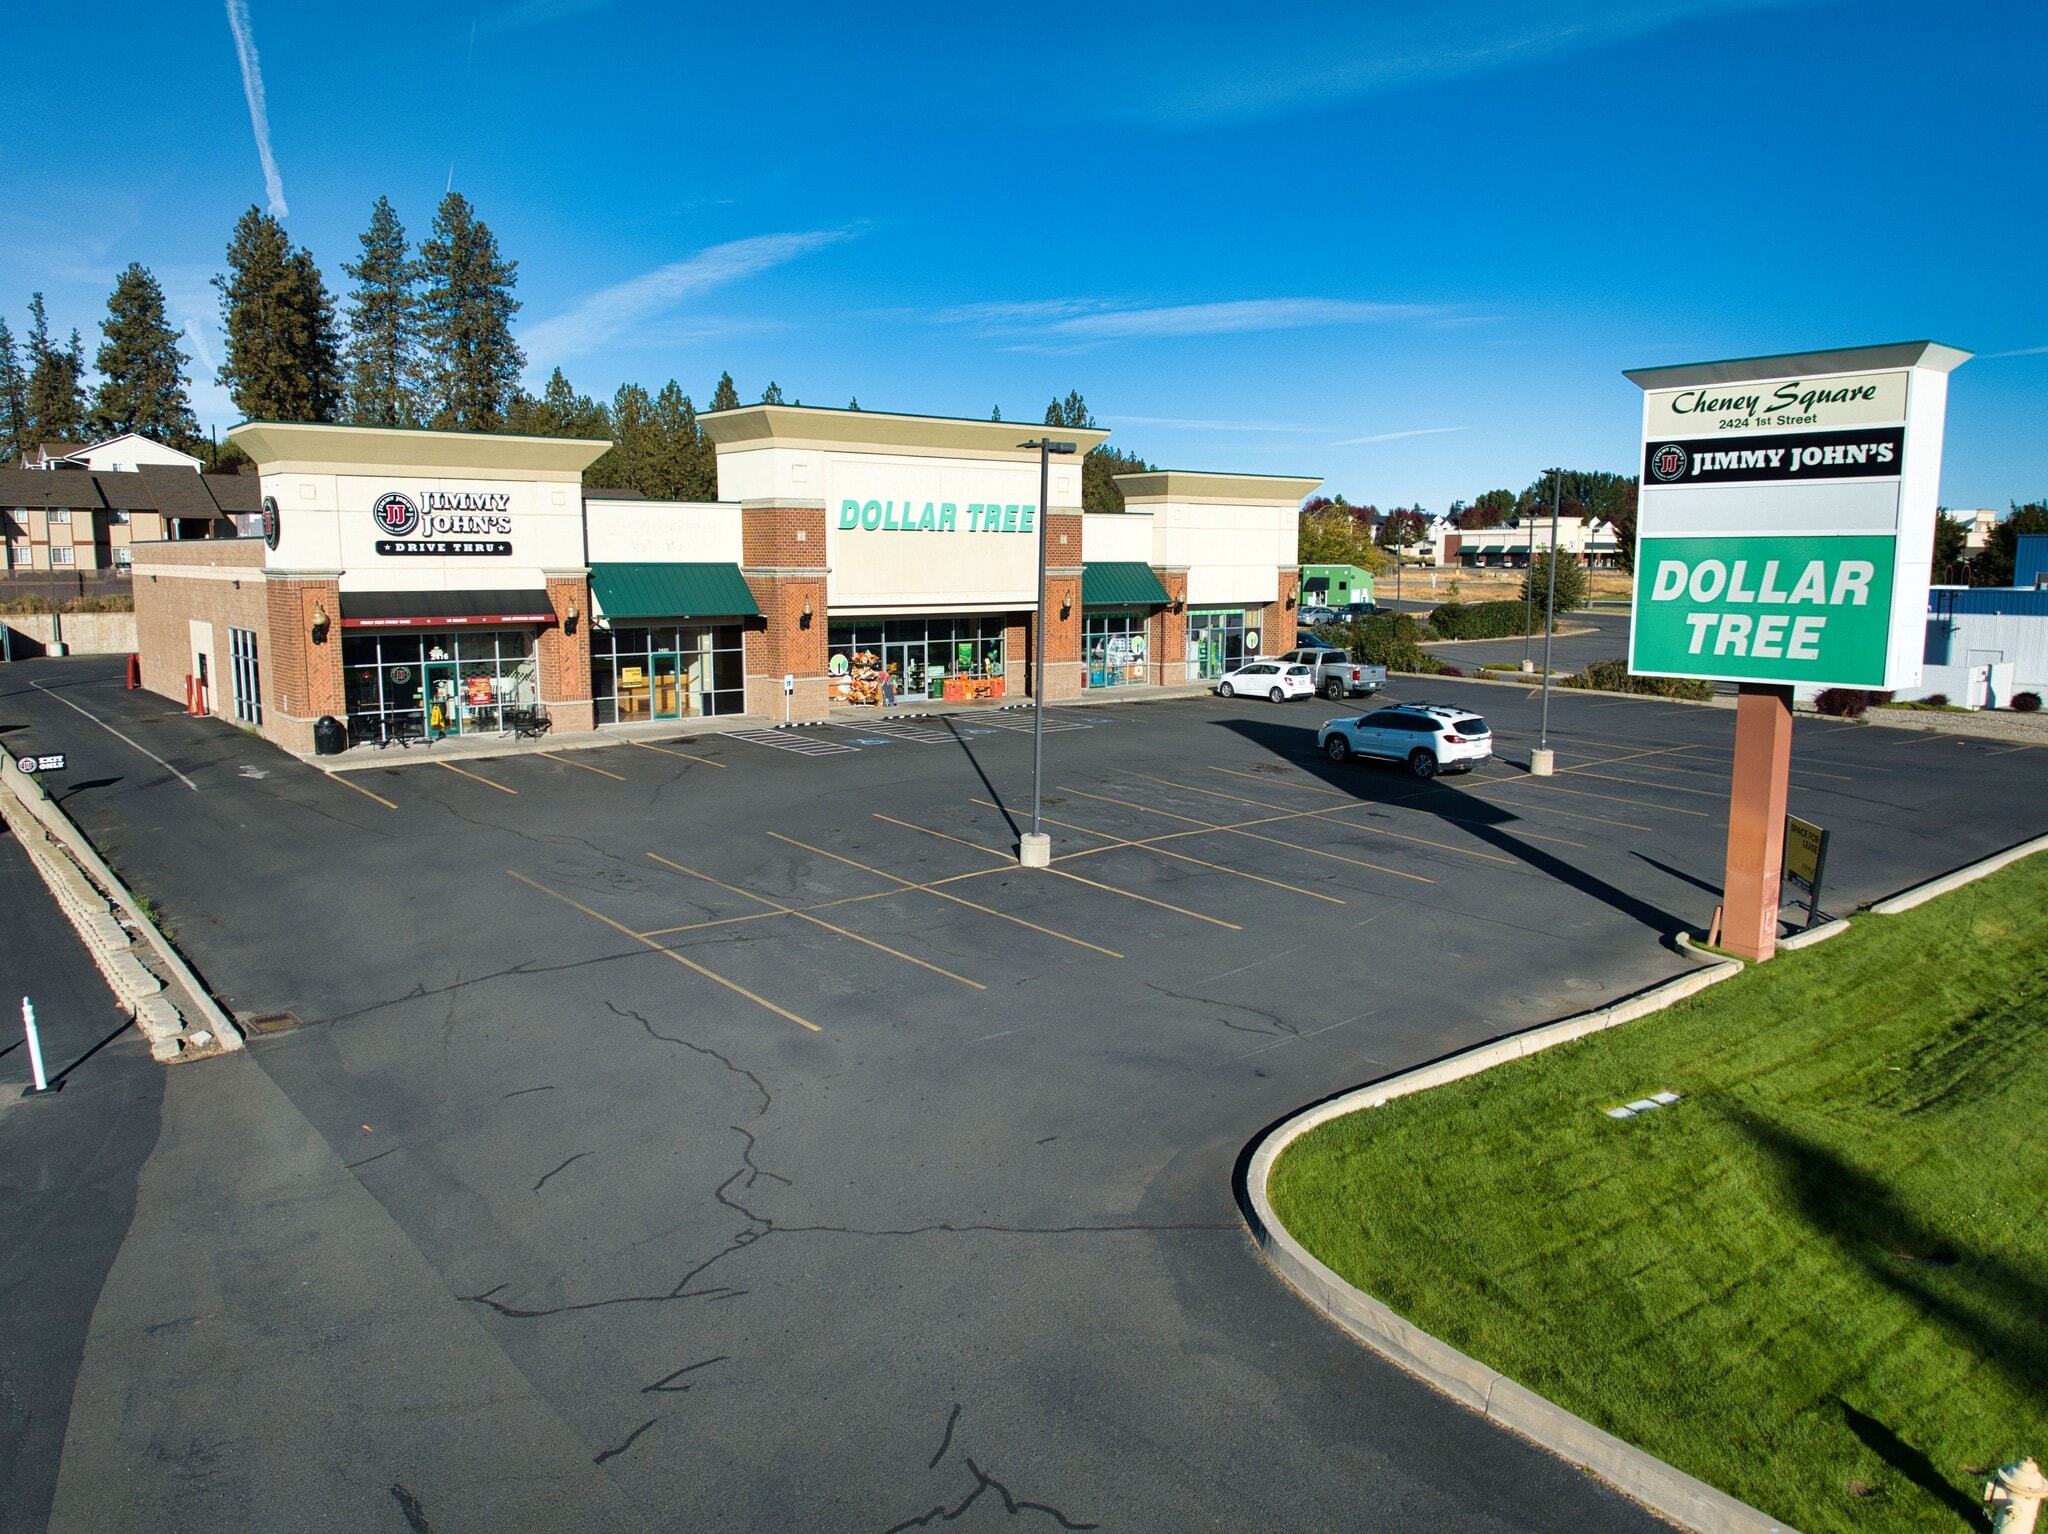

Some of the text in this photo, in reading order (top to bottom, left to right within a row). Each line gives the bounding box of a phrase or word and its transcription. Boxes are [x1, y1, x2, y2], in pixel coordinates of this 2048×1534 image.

[1671, 382, 1877, 417] Cheney Square
[1718, 414, 1818, 430] 2424 1st Street
[1660, 454, 1678, 473] JJ
[1691, 448, 1786, 476] JIMMY
[1789, 442, 1895, 472] JOHN'S
[420, 492, 509, 513] JIMMY
[386, 504, 405, 524] JJ
[838, 500, 1036, 533] DOLLAR TREE
[422, 515, 512, 537] JOHN'S
[395, 543, 494, 552] DRIVE THRU
[1651, 559, 1875, 606] DOLLAR
[1685, 612, 1828, 660] TREE
[1791, 824, 1820, 844] SPACE FOR
[1802, 839, 1819, 854] LEASE
